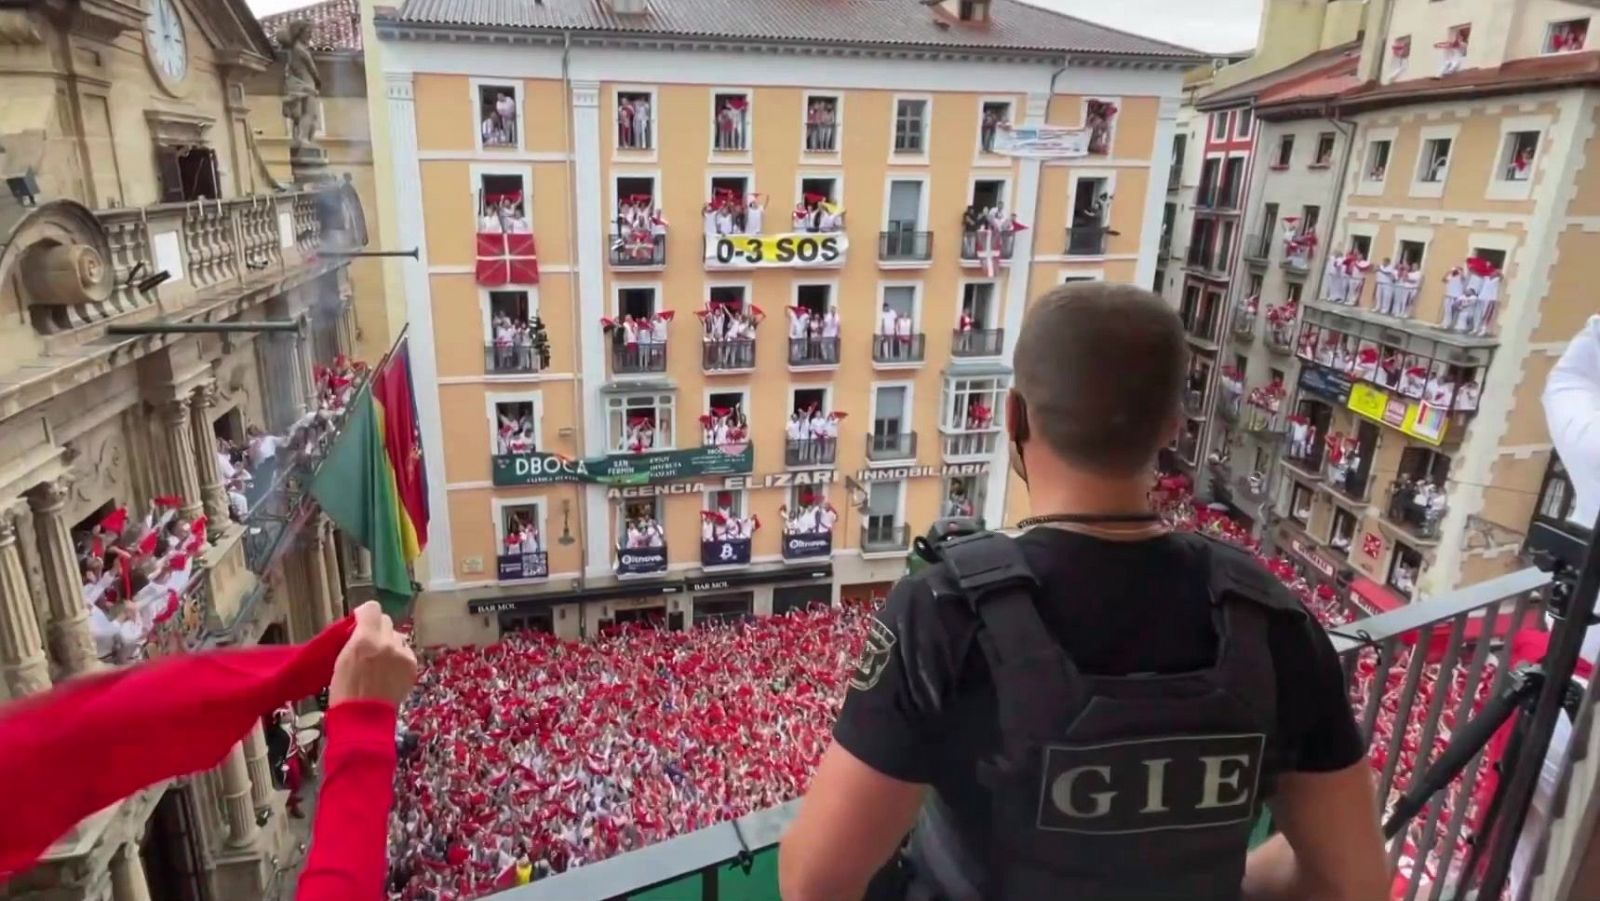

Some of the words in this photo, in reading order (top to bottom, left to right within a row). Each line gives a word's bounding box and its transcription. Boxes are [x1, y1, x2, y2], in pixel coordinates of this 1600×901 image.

[716, 238, 763, 264] 0-3
[775, 238, 839, 262] SOS
[515, 457, 588, 475] DBOCA
[607, 482, 705, 499] AGENCIA
[725, 470, 839, 489] ELIZARI
[857, 463, 990, 480] INMOBILIARIA
[694, 583, 710, 591] BAR
[1052, 754, 1250, 818] GIE
